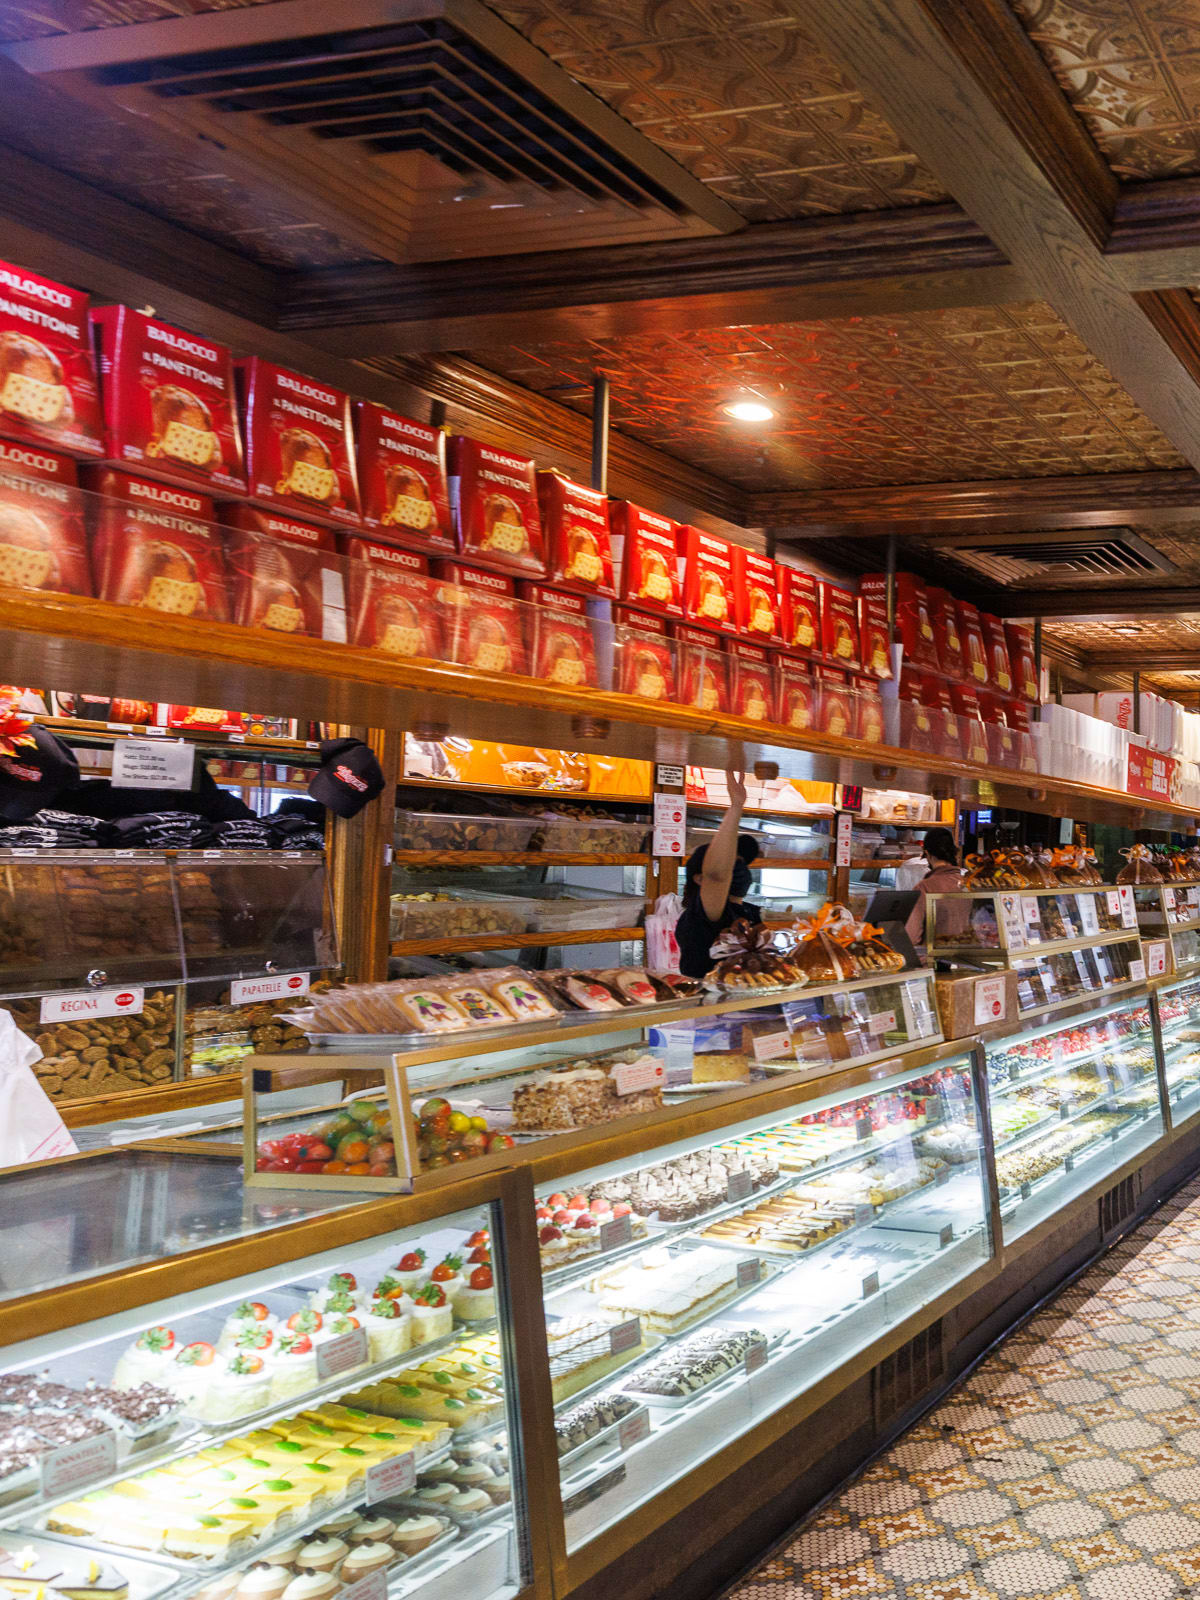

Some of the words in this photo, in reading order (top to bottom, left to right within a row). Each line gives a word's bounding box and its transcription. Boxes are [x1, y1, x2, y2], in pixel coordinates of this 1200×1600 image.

[0, 270, 72, 308] ALOCCO
[0, 298, 80, 340] ANETTONE
[147, 325, 217, 362] BALOCCO
[152, 353, 225, 390] PANETTONE
[277, 374, 337, 407] BALOCCO
[281, 399, 344, 432] PANETTONE
[382, 415, 434, 442] BALOCCO
[0, 444, 58, 472] LOCCO
[129, 481, 201, 512] BALOCCO
[136, 510, 210, 539] PANETTONE
[268, 519, 319, 541] BALOCCO
[370, 546, 421, 568] BALOCCO
[463, 570, 507, 590] BALOCCO
[542, 592, 581, 610] BALOCCO
[241, 982, 281, 996] PAPATELLE
[60, 999, 98, 1012] REGINA
